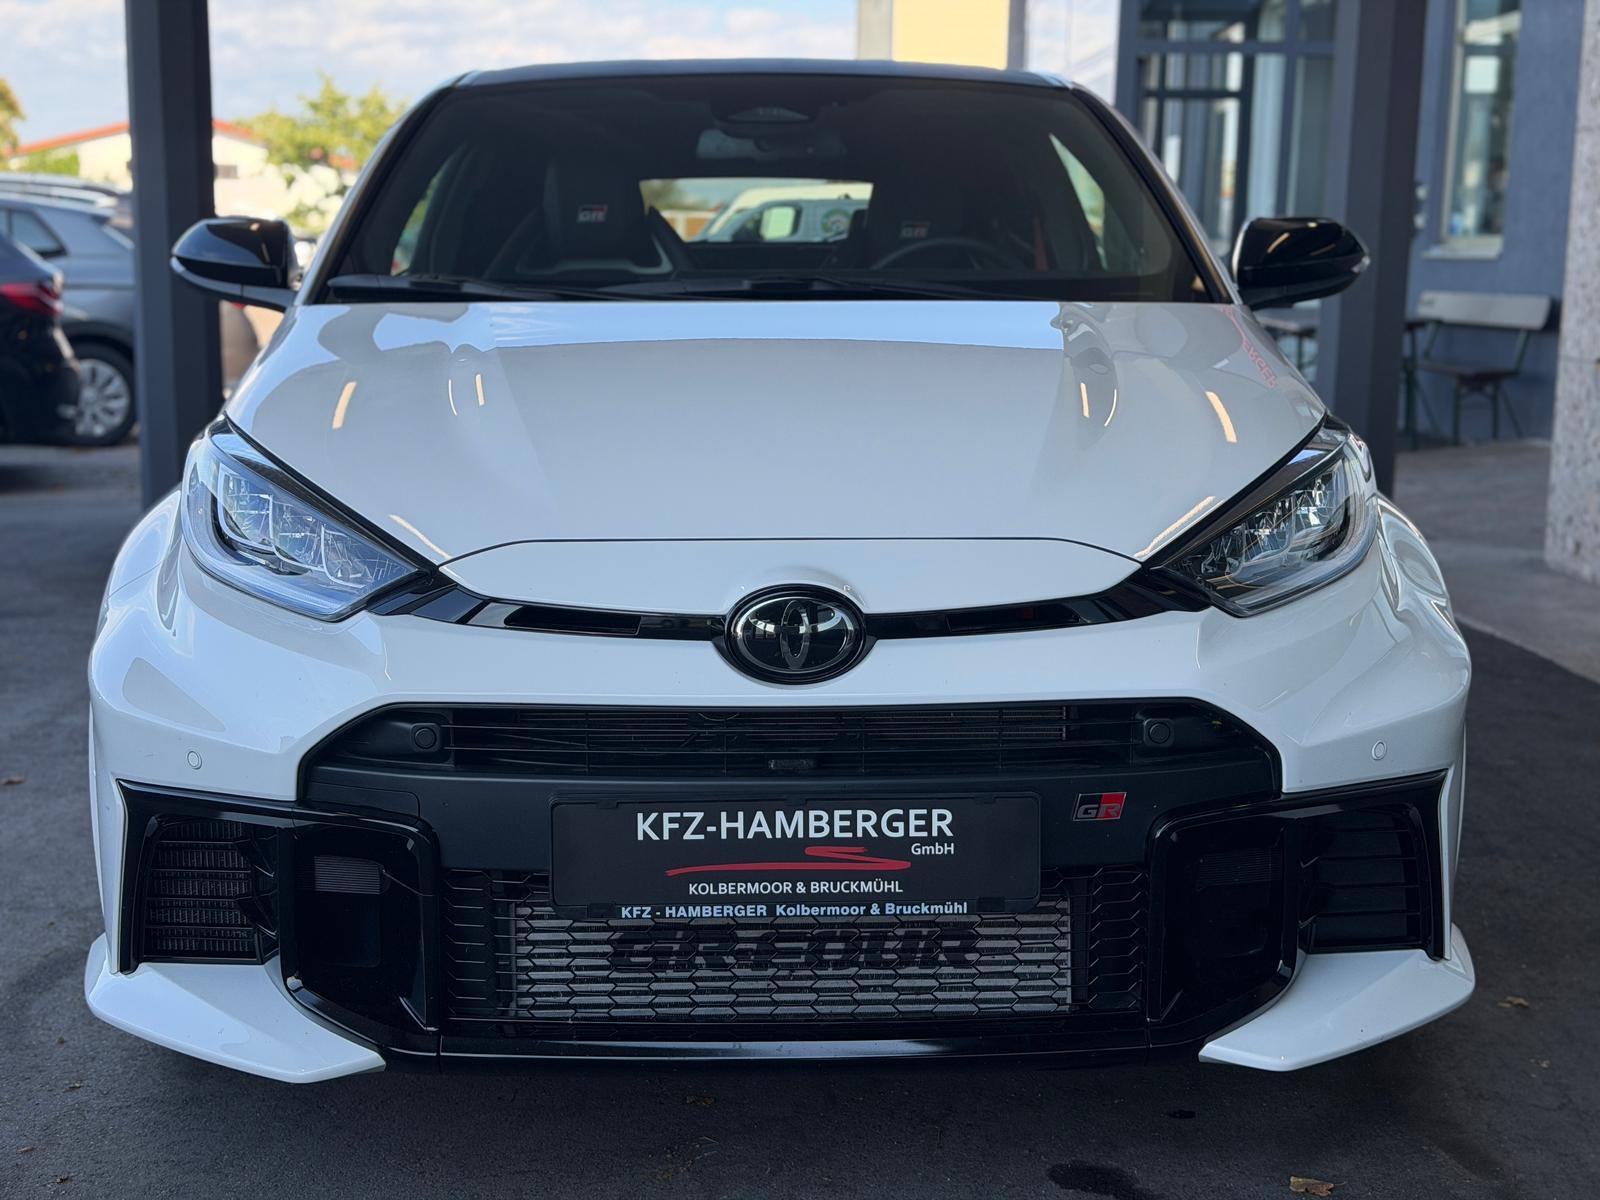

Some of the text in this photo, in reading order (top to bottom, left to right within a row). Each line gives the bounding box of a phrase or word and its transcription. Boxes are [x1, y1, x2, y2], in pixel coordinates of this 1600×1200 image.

[636, 808, 954, 841] KFZ-HAMBERGER
[911, 843, 955, 856] GmbH
[688, 878, 904, 895] KOLBERMOOR & BRUCKMÜHL
[621, 907, 651, 919] KFZ
[665, 905, 767, 918] HAMBERGER
[776, 904, 866, 917] Kolbermoor
[870, 903, 881, 916] &
[885, 902, 968, 915] Bruckmühl
